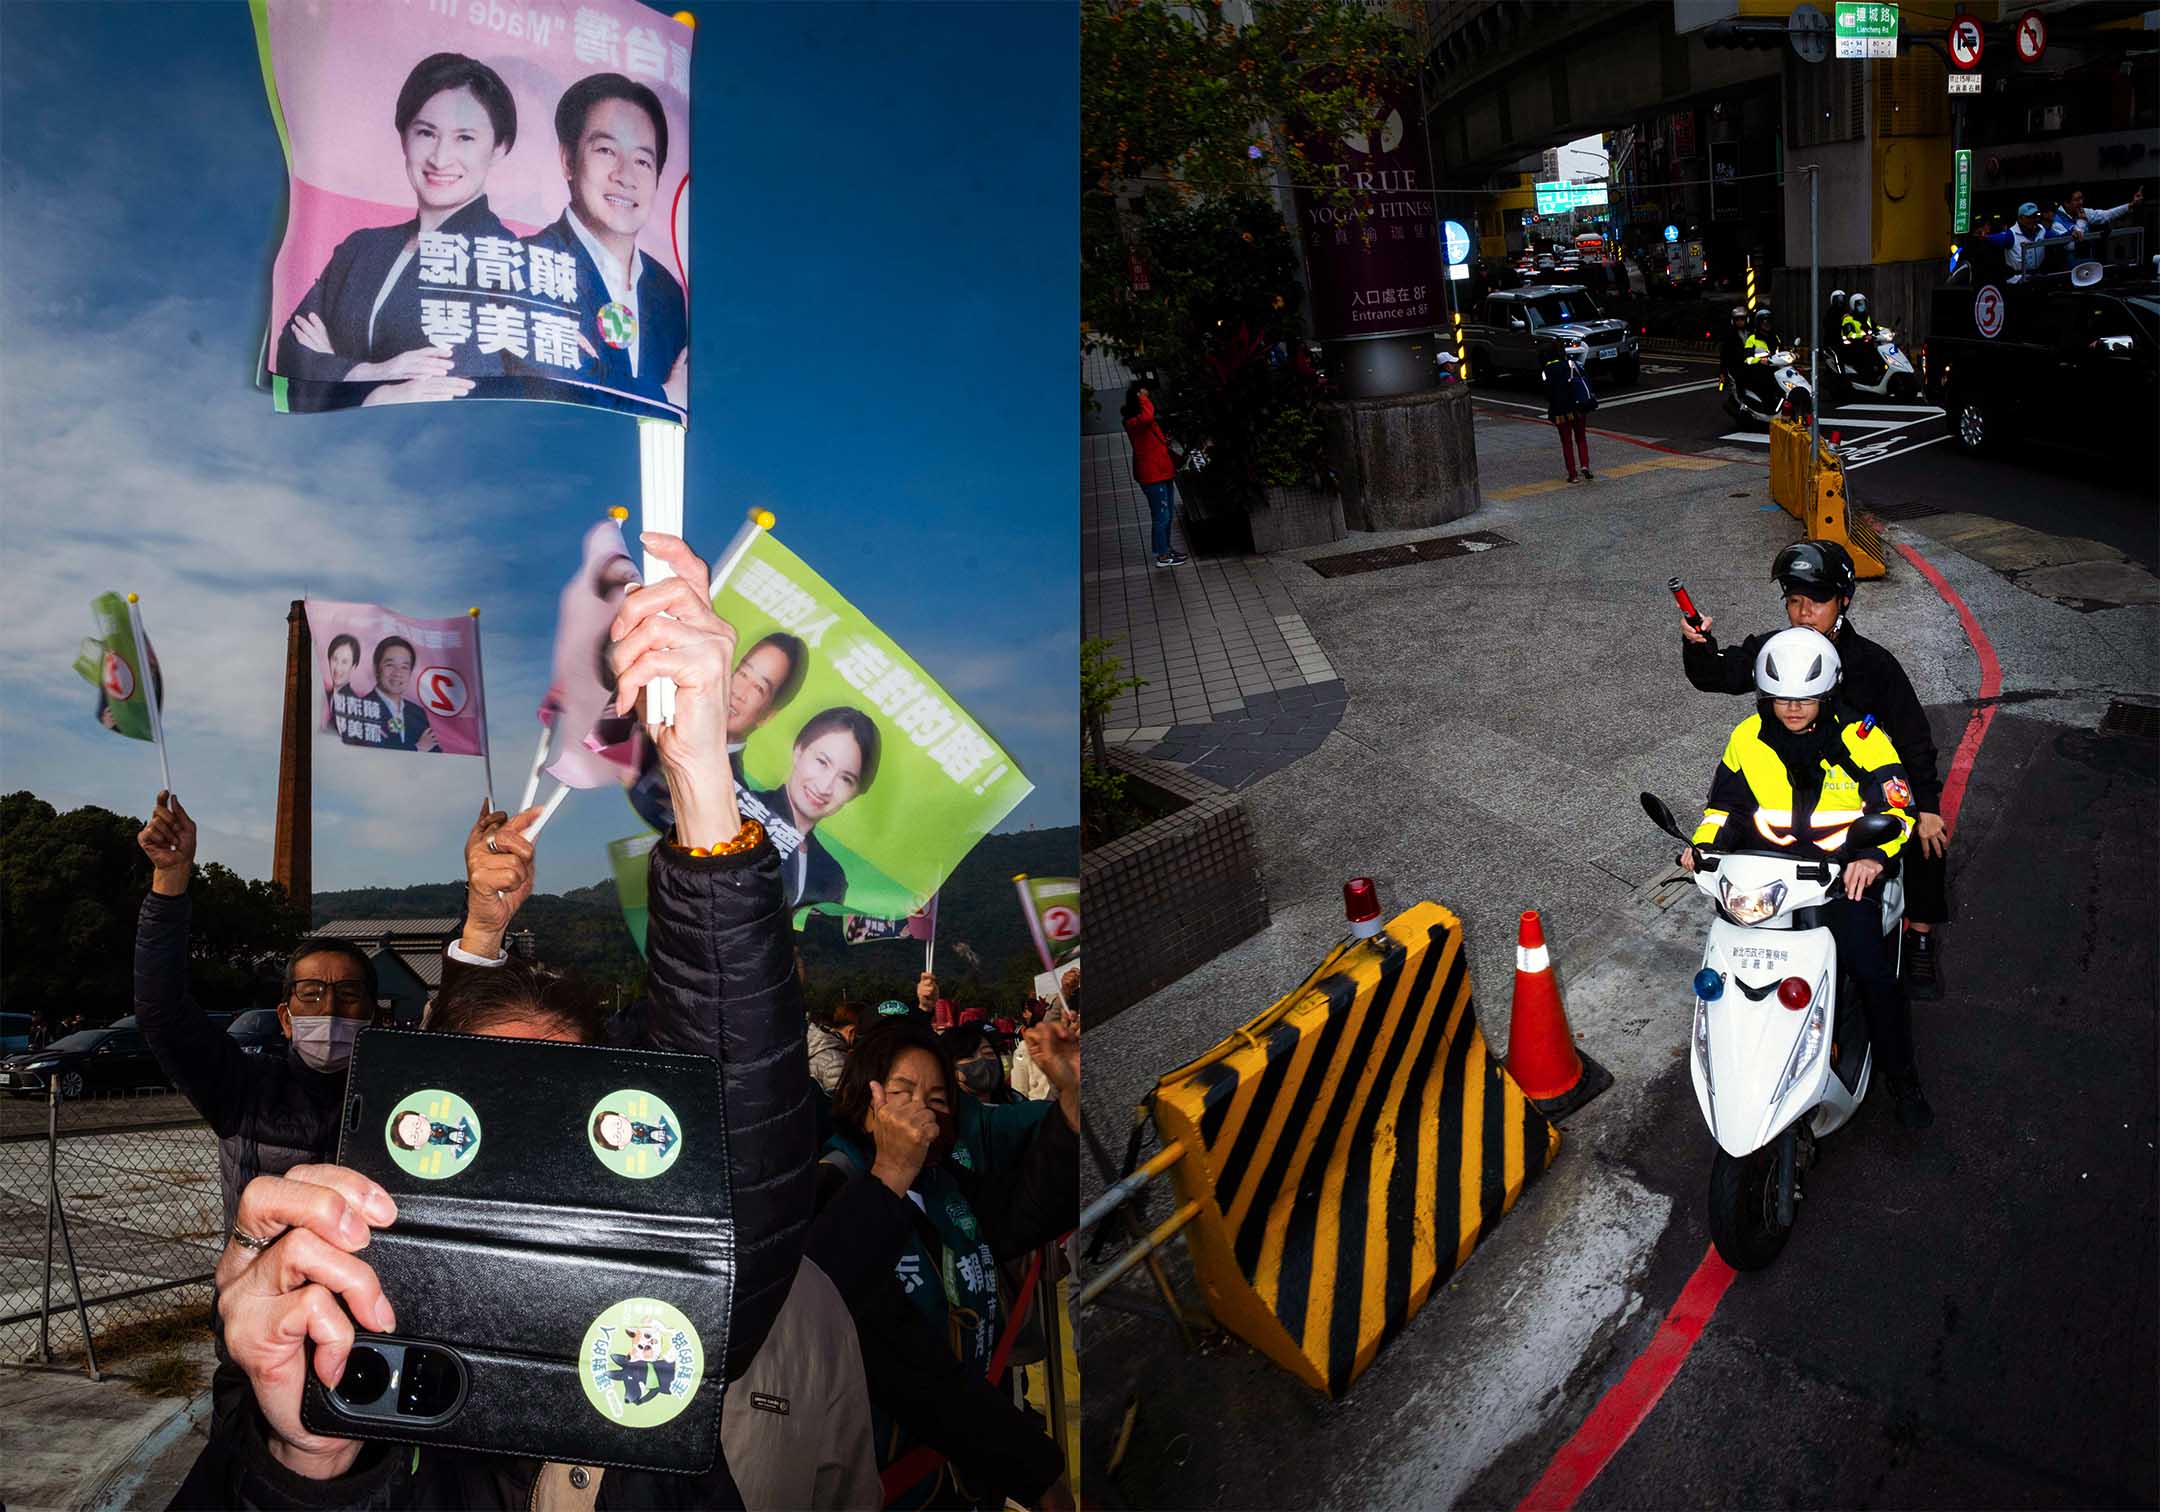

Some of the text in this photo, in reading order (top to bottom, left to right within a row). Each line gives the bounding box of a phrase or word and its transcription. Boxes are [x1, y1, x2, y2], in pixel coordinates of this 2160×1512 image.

[1351, 287, 1410, 306] 入口處在
[1351, 303, 1430, 322] Entrance at 8F
[1983, 294, 1997, 327] 3
[1824, 781, 1857, 791] POLICE
[1050, 911, 1073, 937] 2
